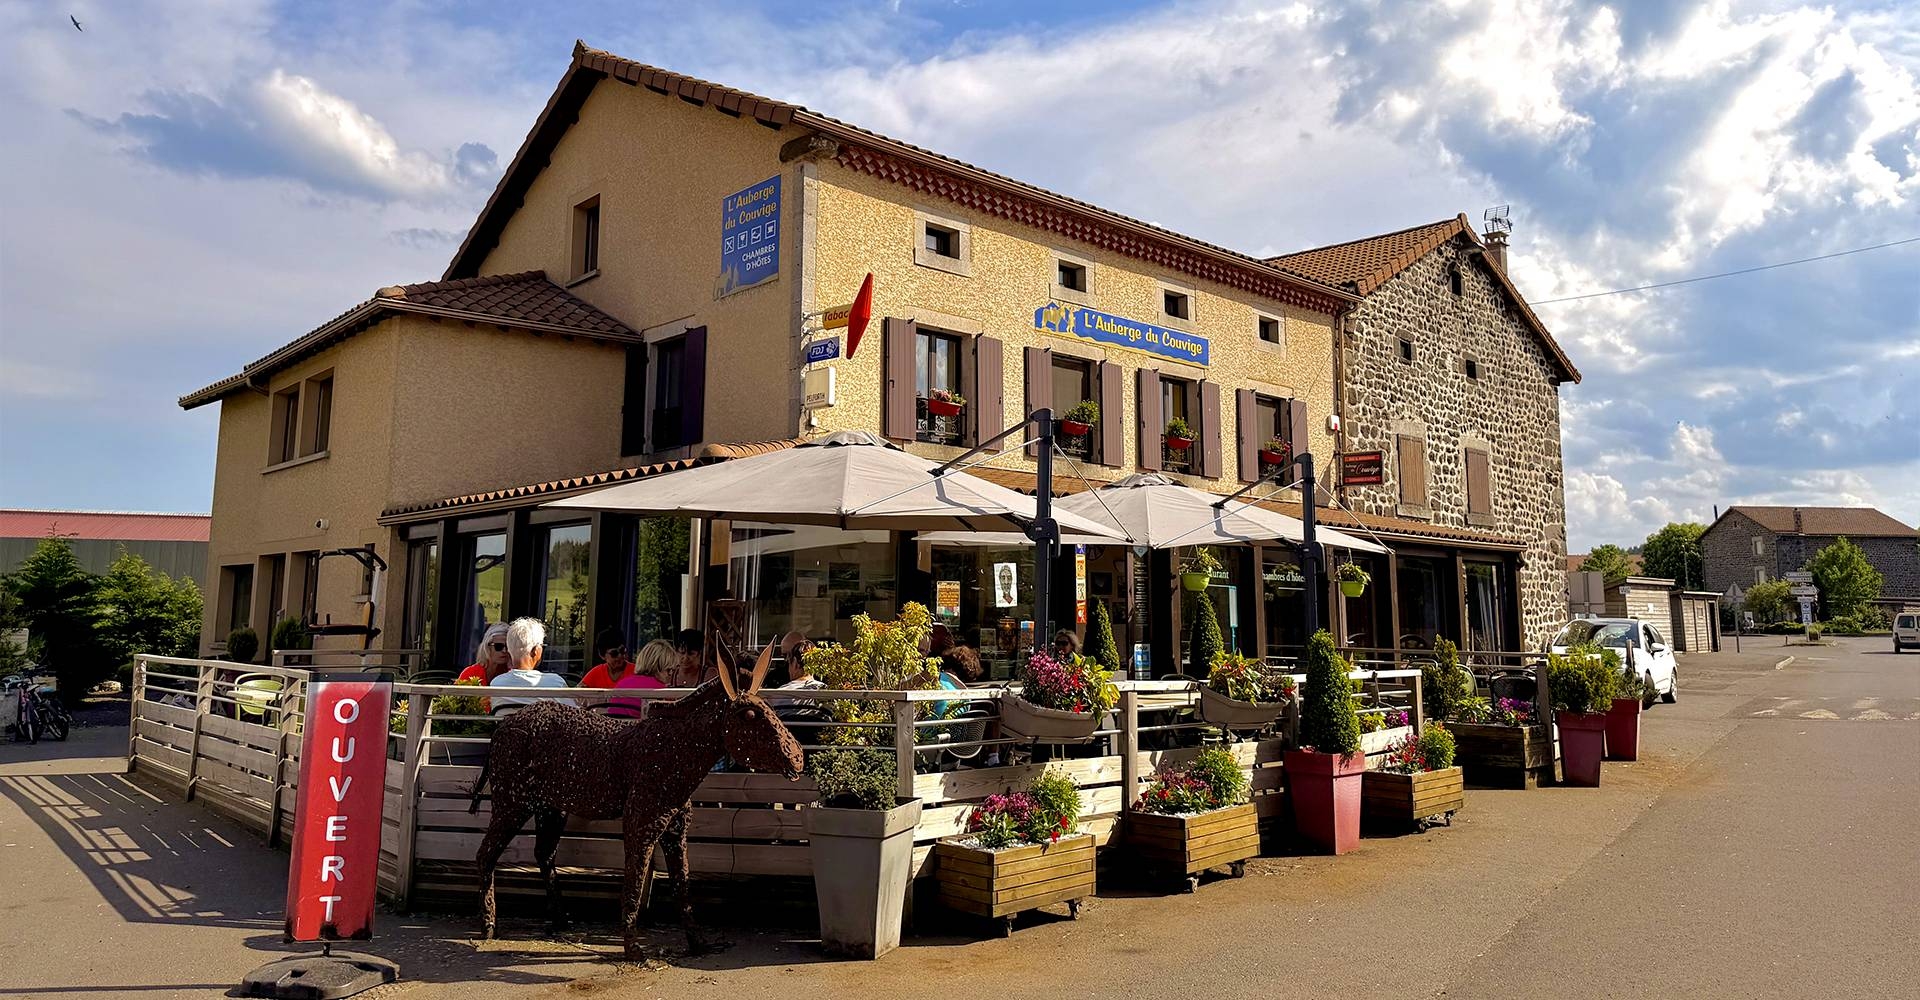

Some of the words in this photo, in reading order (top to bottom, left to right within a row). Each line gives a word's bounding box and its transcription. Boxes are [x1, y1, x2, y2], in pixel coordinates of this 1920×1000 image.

[728, 184, 775, 212] L'Auberge
[725, 216, 736, 230] du
[739, 202, 777, 225] Couvige
[742, 243, 775, 261] CHAMBRES
[746, 255, 772, 271] D'HÔTES
[823, 310, 849, 322] Tabac
[1084, 312, 1142, 342] L'Auberge
[1145, 328, 1159, 344] du
[1162, 331, 1203, 356] Couvige
[811, 346, 825, 356] FDJ
[1262, 569, 1285, 581] hambres
[318, 698, 360, 922] OUVERT
